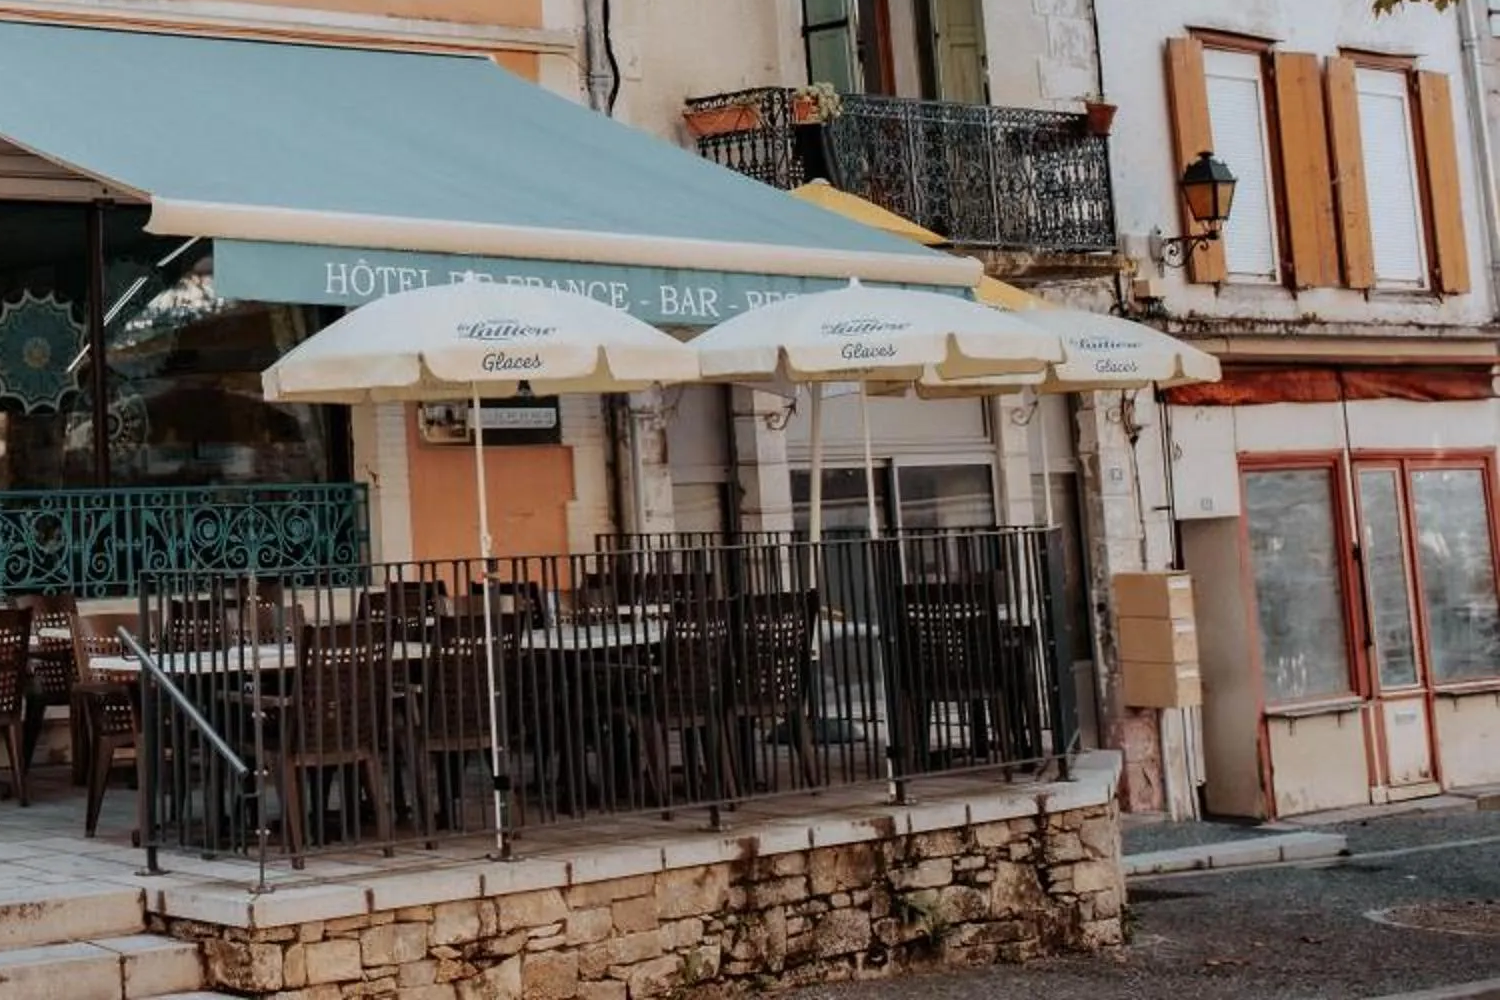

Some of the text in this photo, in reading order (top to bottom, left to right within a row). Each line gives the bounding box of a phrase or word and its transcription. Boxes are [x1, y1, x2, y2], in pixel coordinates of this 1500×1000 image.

[324, 258, 430, 297] HÔTEL
[505, 275, 629, 312] NCE
[659, 285, 720, 317] BAR
[841, 343, 897, 360] Glaces
[481, 352, 542, 372] Glaces
